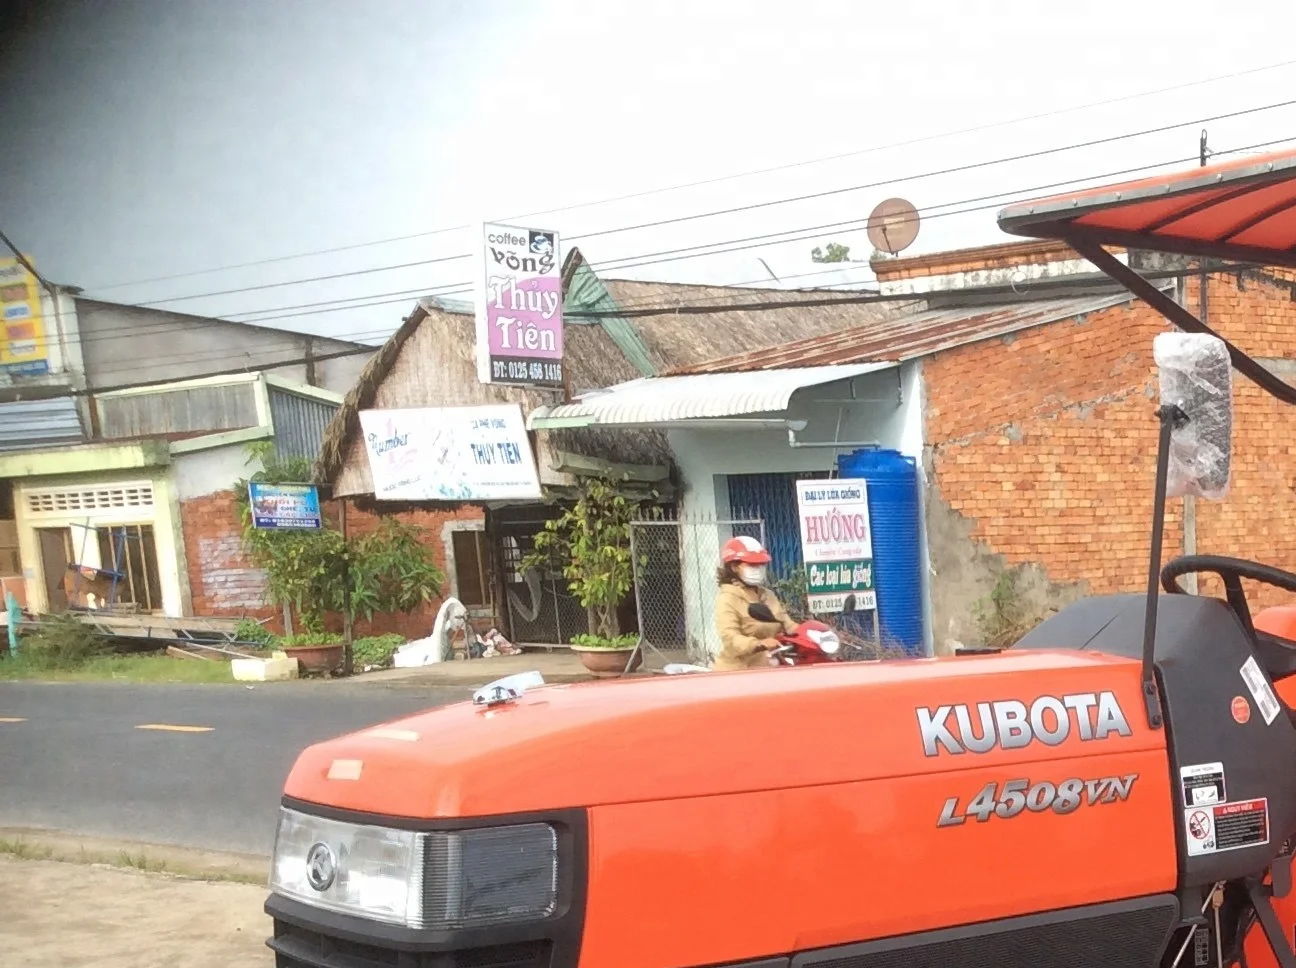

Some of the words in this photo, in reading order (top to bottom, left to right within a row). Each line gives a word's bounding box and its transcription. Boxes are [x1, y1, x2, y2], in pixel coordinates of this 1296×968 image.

[488, 232, 526, 246] coffee
[488, 275, 559, 319] Thủy
[495, 316, 556, 351] Tiên
[915, 690, 1133, 757] KUBOTA
[936, 773, 1139, 828] L4508VN
